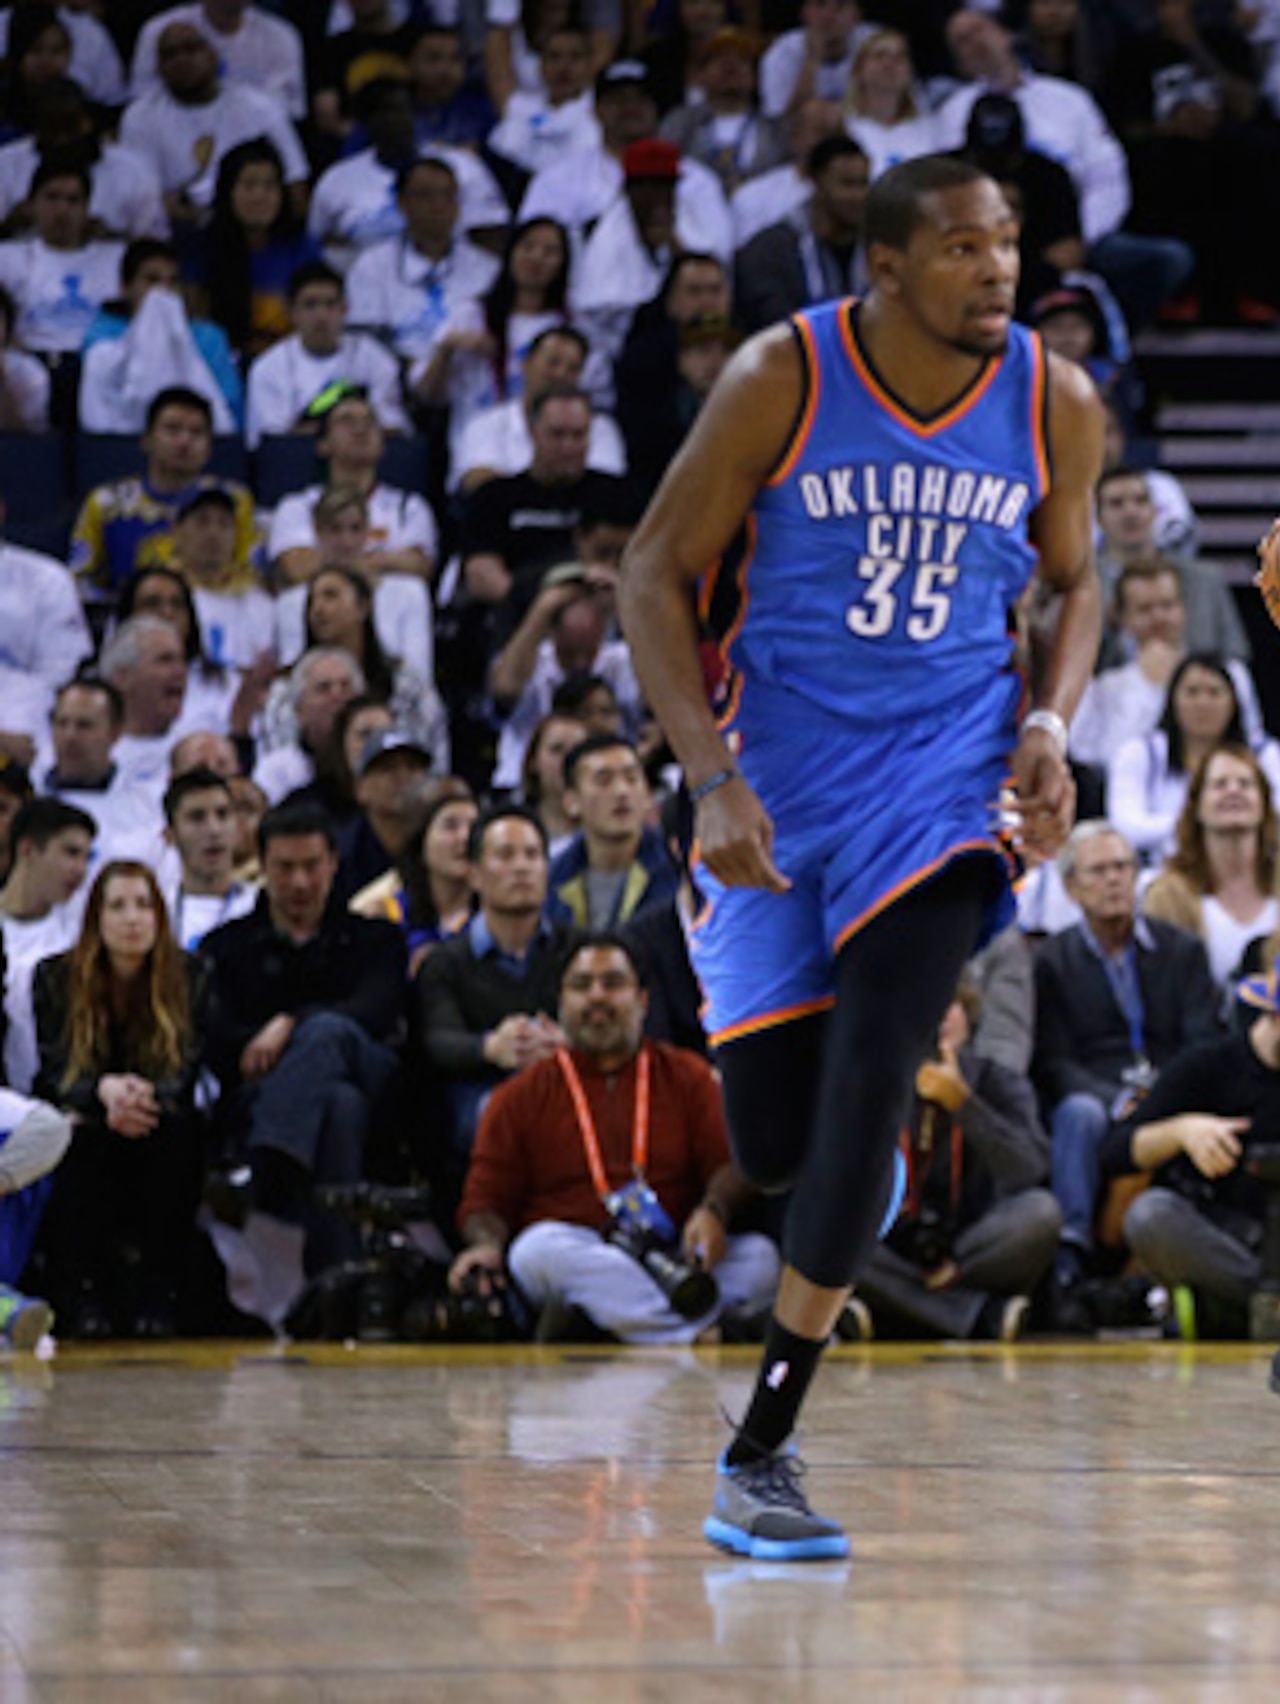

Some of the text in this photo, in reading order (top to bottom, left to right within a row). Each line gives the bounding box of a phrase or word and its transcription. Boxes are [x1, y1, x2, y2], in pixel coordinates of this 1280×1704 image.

[799, 461, 1029, 530] OKLAHOMA
[867, 513, 968, 565] CITY
[845, 556, 959, 641] 35
